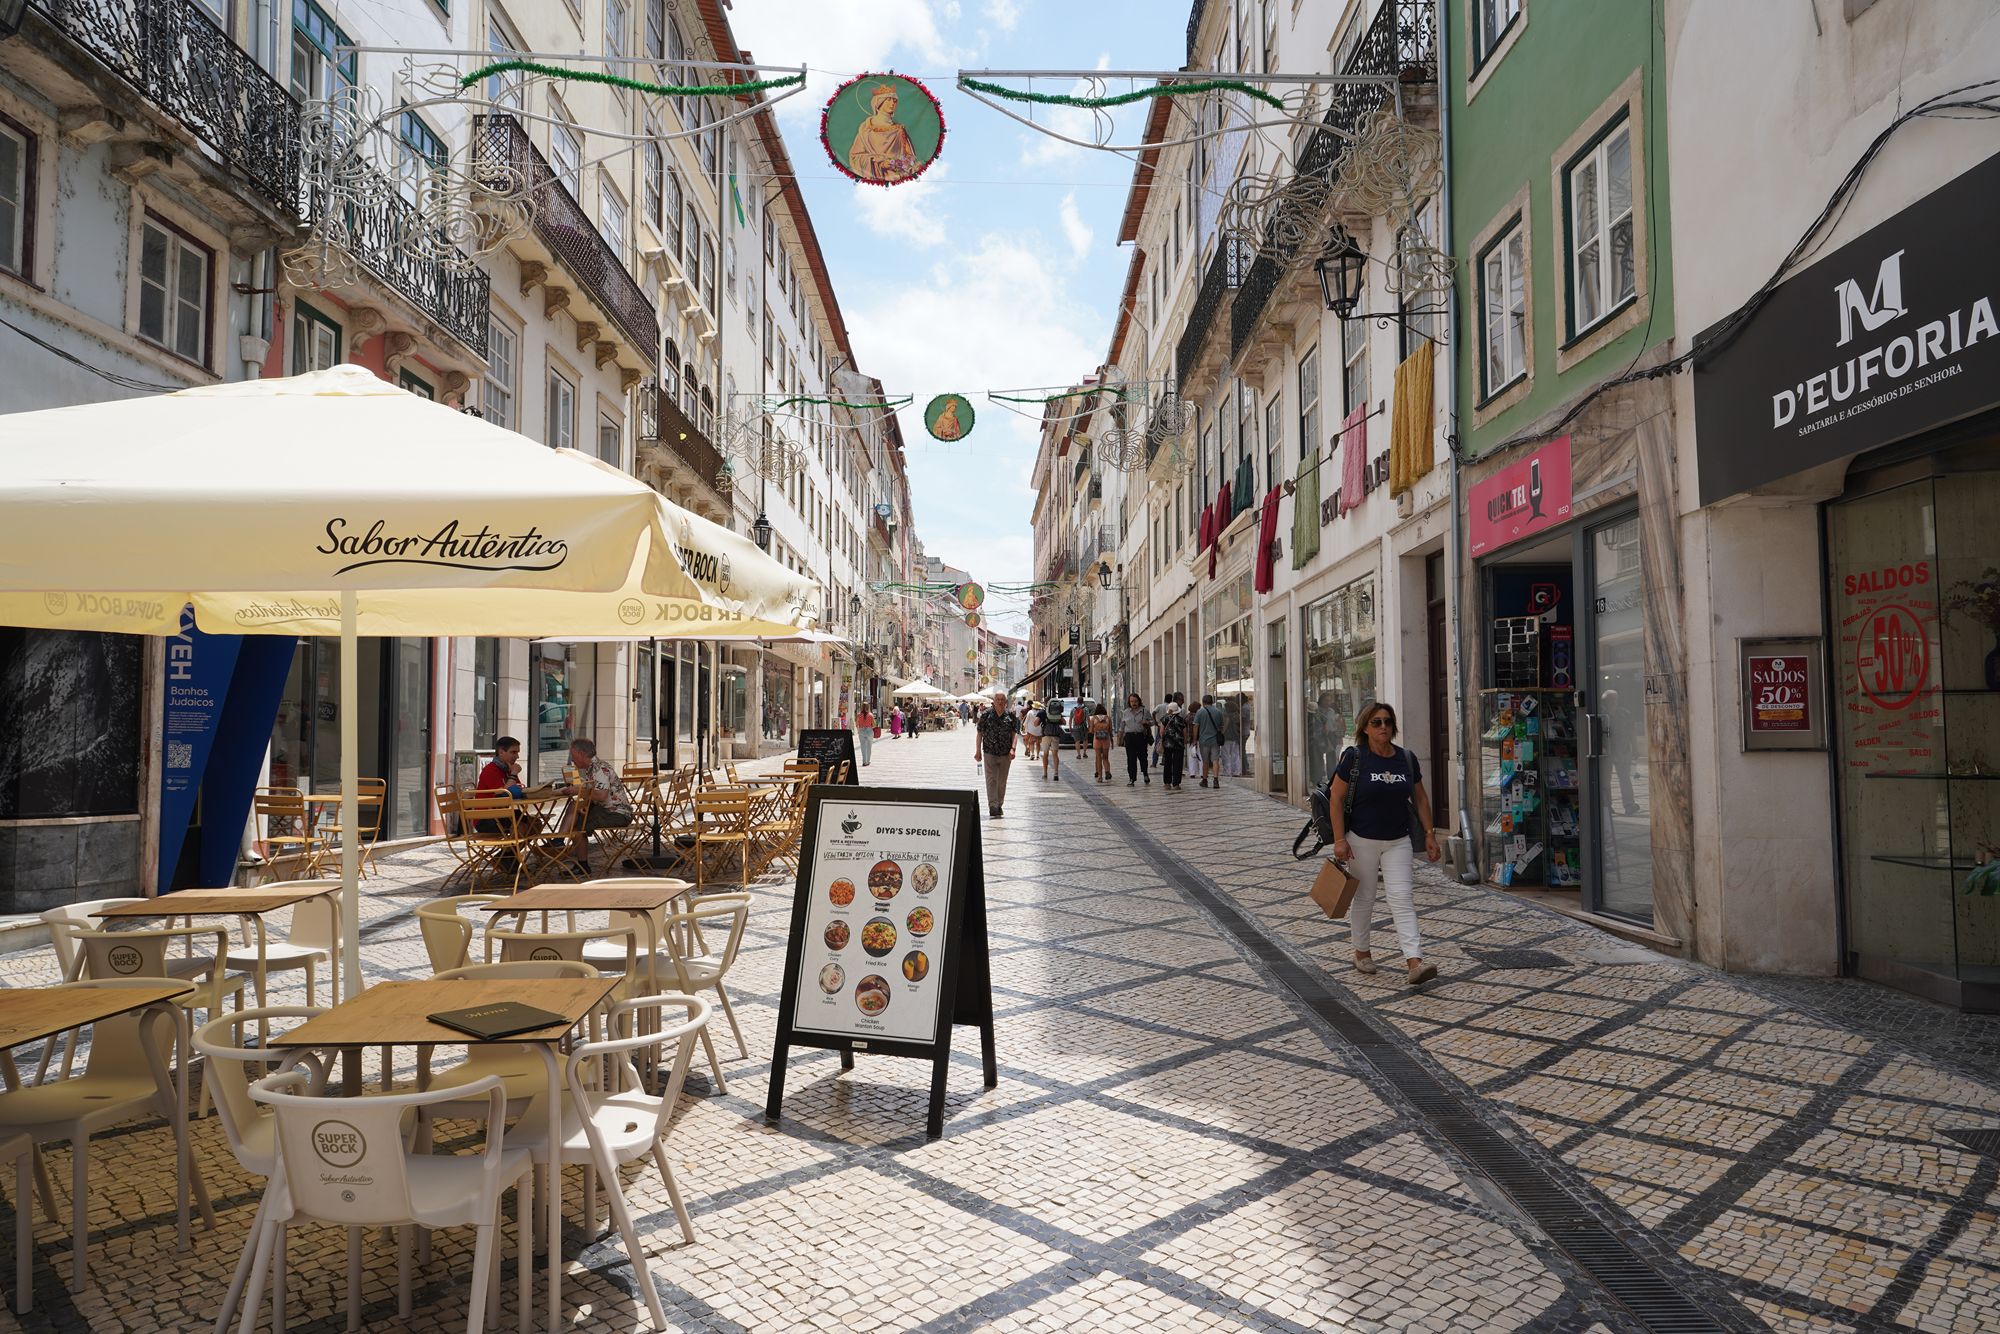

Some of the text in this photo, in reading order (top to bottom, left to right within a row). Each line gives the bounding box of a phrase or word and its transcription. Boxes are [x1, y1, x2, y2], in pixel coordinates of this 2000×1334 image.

[1772, 296, 2000, 429] D'EUFORIA
[1798, 364, 1963, 437] SAPATARIA E ACESSÓRIOS DE SENHORA
[316, 518, 568, 570] Sabor Autêntico
[693, 551, 719, 583] BOCK
[1844, 562, 1930, 596] SALDOS
[1596, 599, 1606, 612] 18
[1874, 613, 1921, 692] 50%
[1754, 670, 1806, 683] SALDOS
[170, 686, 209, 696] Banhos
[1760, 686, 1802, 704] 50%
[876, 827, 941, 837] DIYA'S SPECIAL
[317, 1133, 358, 1144] SUPER
[321, 1143, 358, 1154] BOCK
